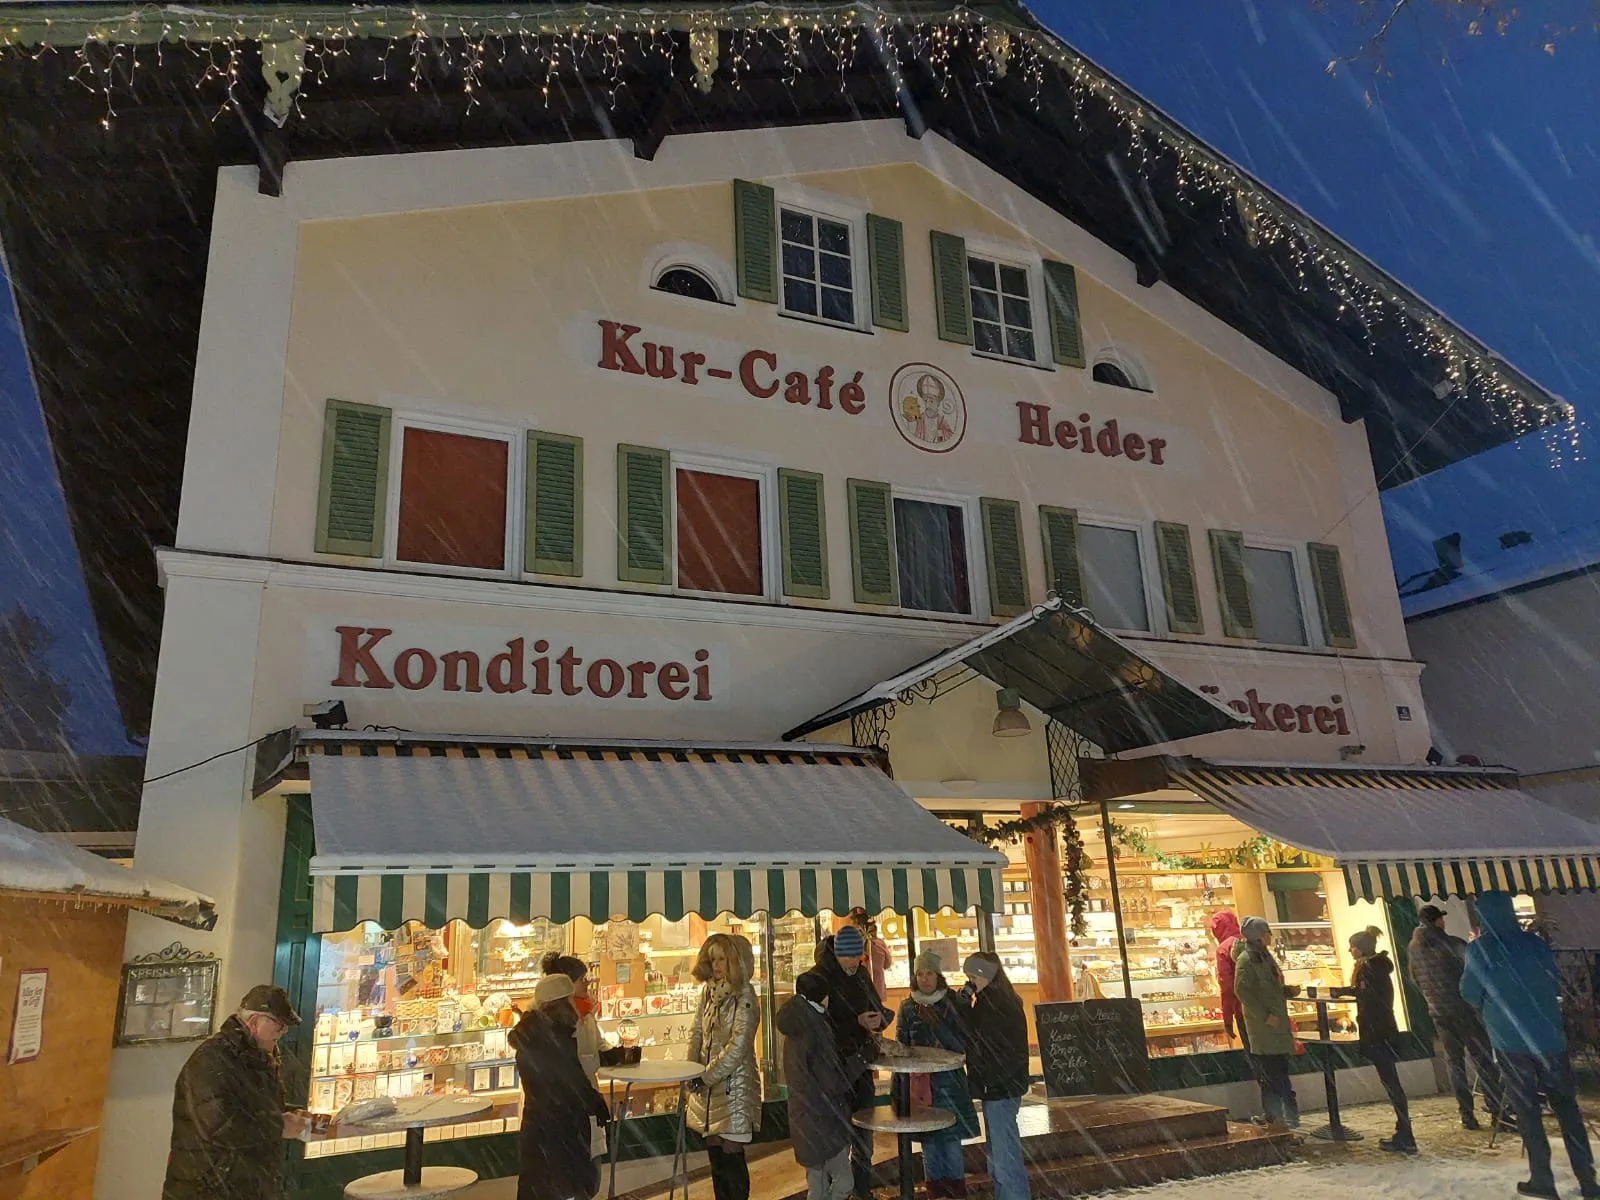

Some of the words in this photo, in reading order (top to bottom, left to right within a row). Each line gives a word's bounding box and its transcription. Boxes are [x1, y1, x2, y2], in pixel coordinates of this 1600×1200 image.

[597, 319, 866, 415] Kur-Café
[1015, 401, 1167, 465] Heider
[331, 625, 713, 701] Konditorei
